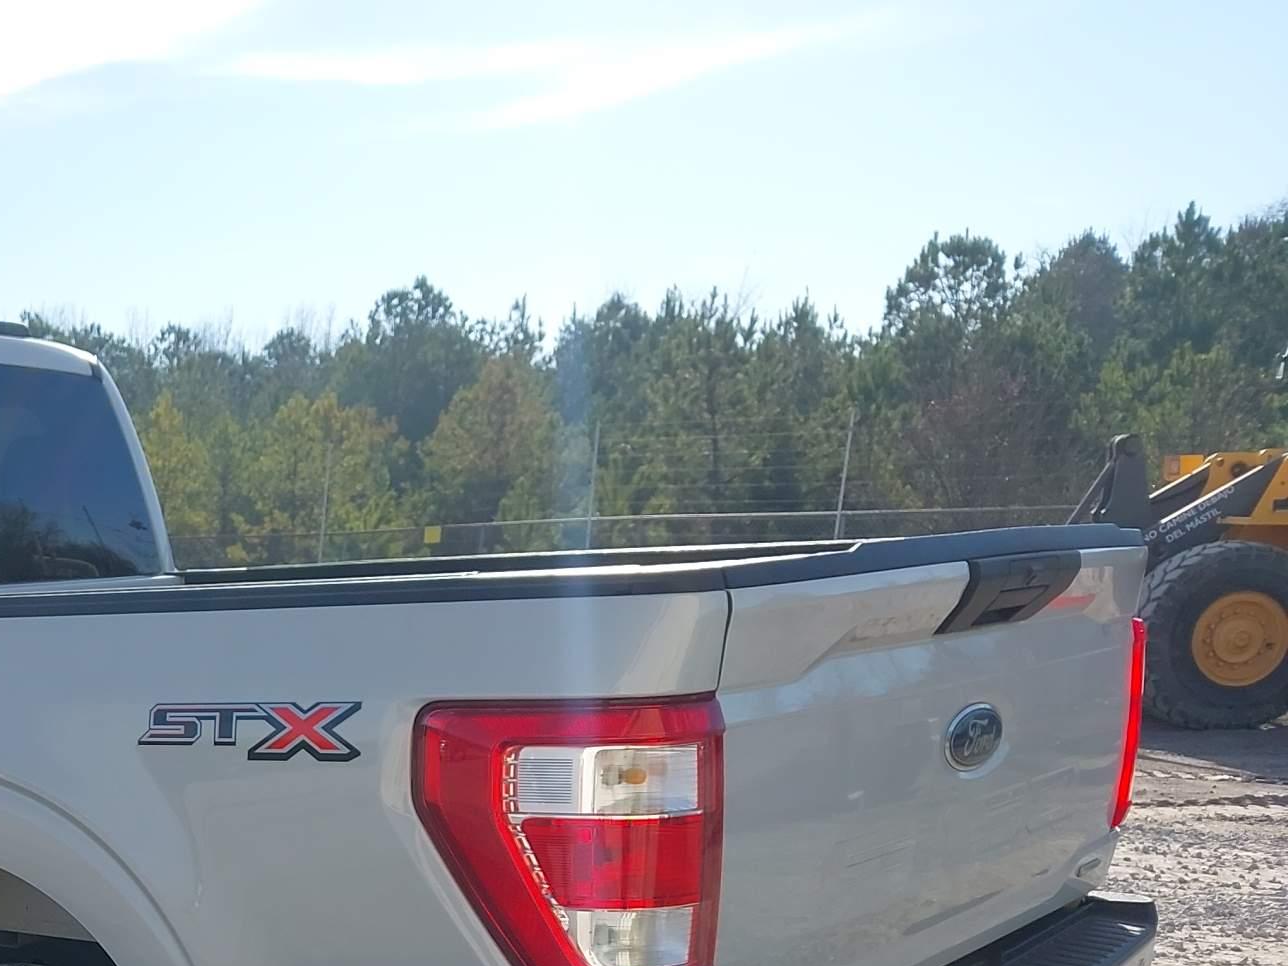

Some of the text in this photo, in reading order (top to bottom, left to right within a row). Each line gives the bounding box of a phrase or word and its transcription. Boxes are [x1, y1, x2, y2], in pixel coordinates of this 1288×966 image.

[1159, 510, 1196, 533] CAMINE
[1198, 487, 1235, 511] DEBAJO
[1165, 528, 1186, 543] DEL
[138, 702, 362, 762] STX
